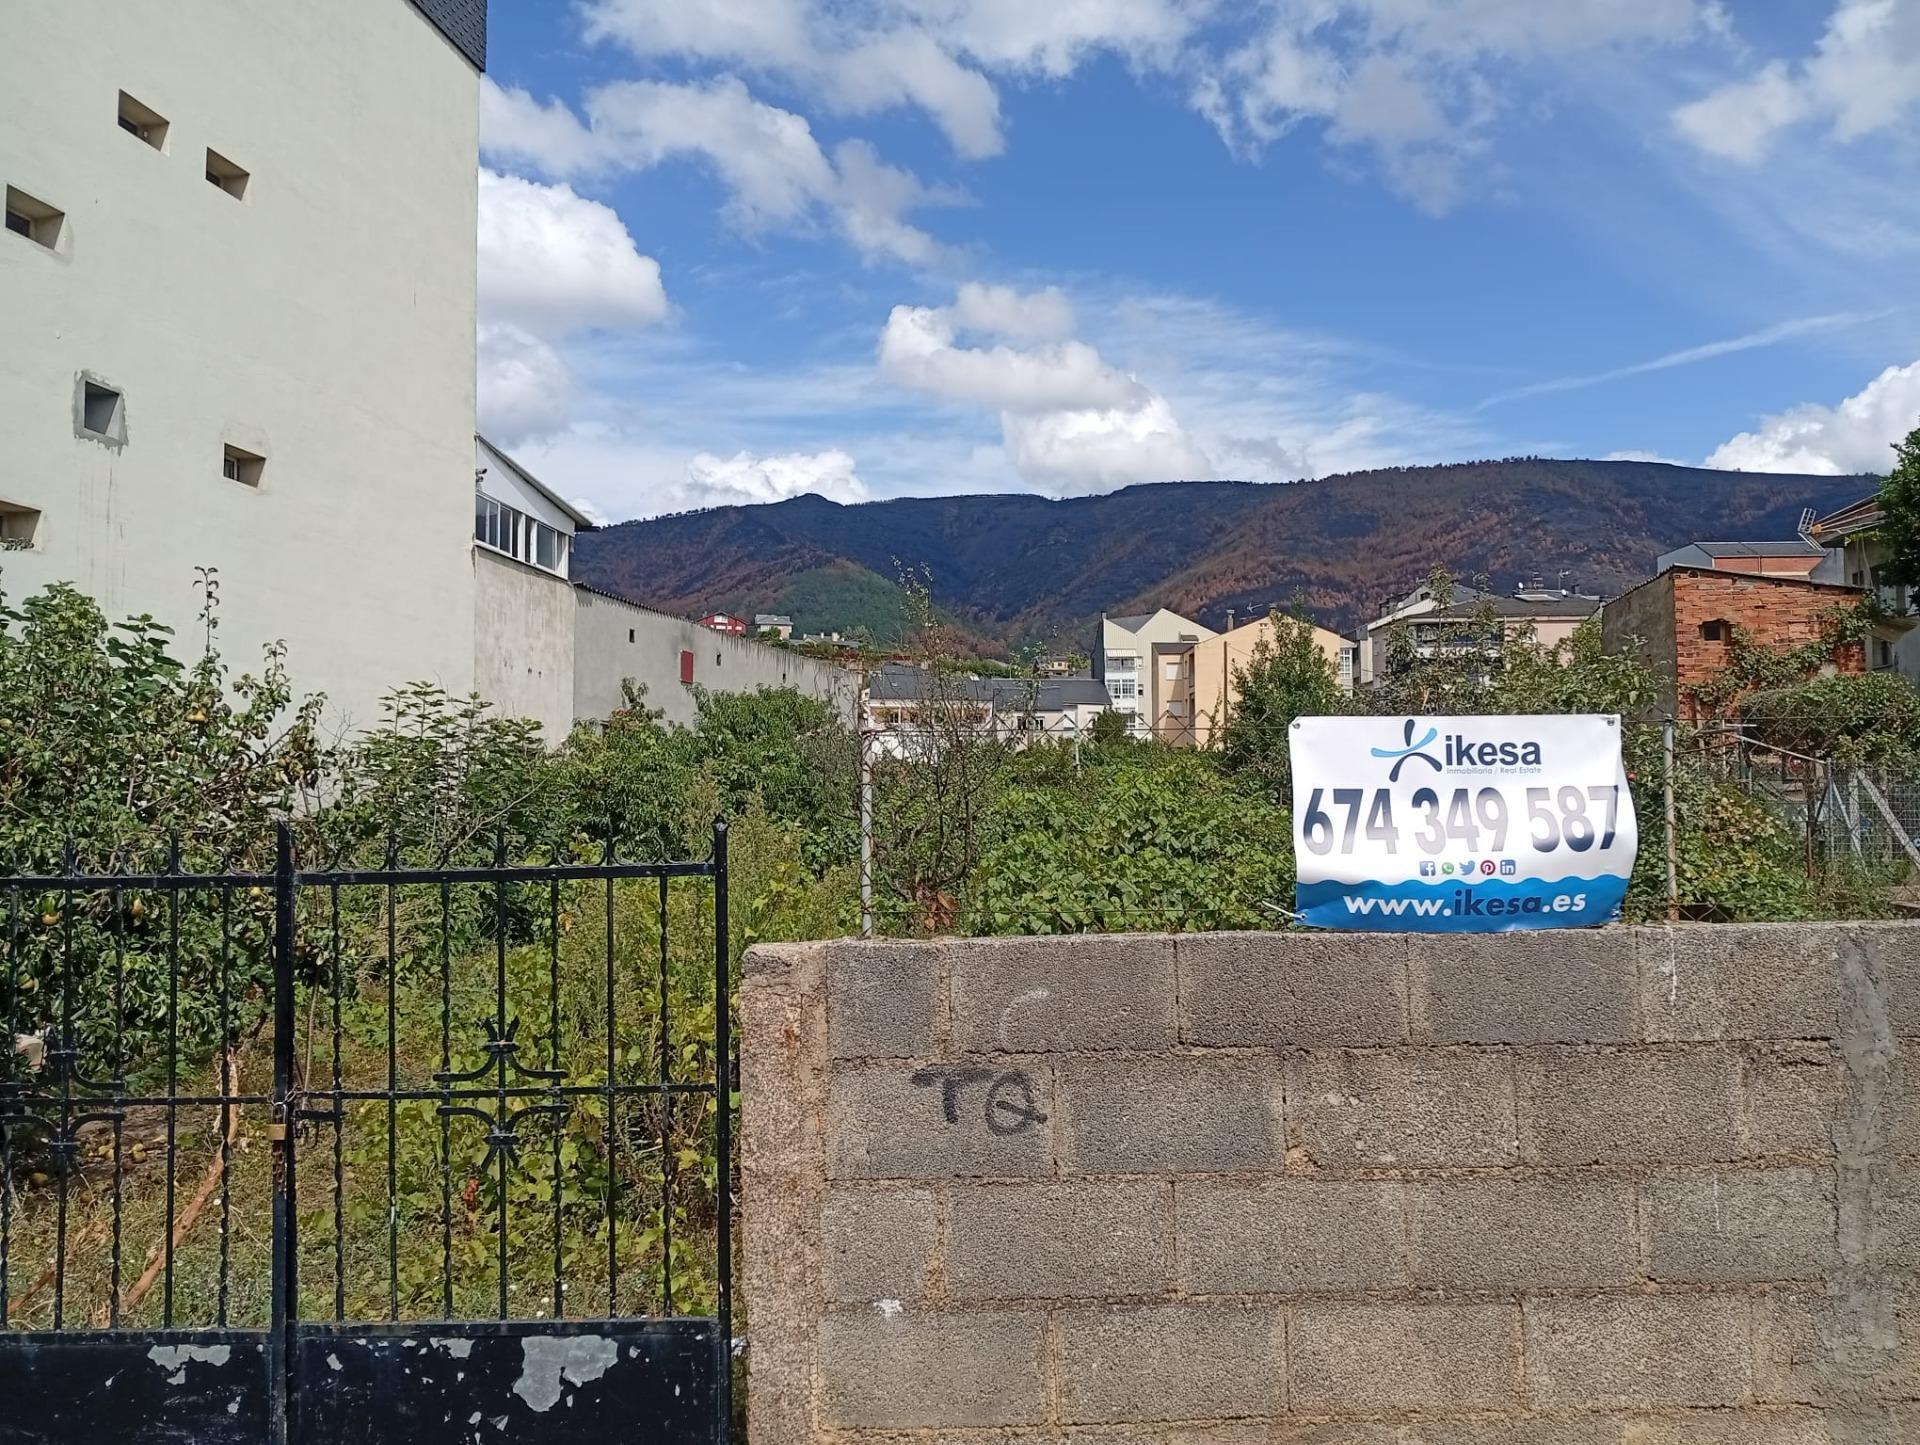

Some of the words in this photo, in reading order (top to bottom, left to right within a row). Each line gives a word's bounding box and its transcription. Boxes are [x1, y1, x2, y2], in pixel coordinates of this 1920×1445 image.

[1445, 735, 1542, 766] ikesa
[1500, 766, 1518, 775] Real
[1519, 766, 1542, 774] Estate
[1302, 788, 1400, 856] 674
[1411, 787, 1508, 855] 349
[1526, 785, 1619, 853] 587
[1343, 889, 1587, 917] www.ikesa.es
